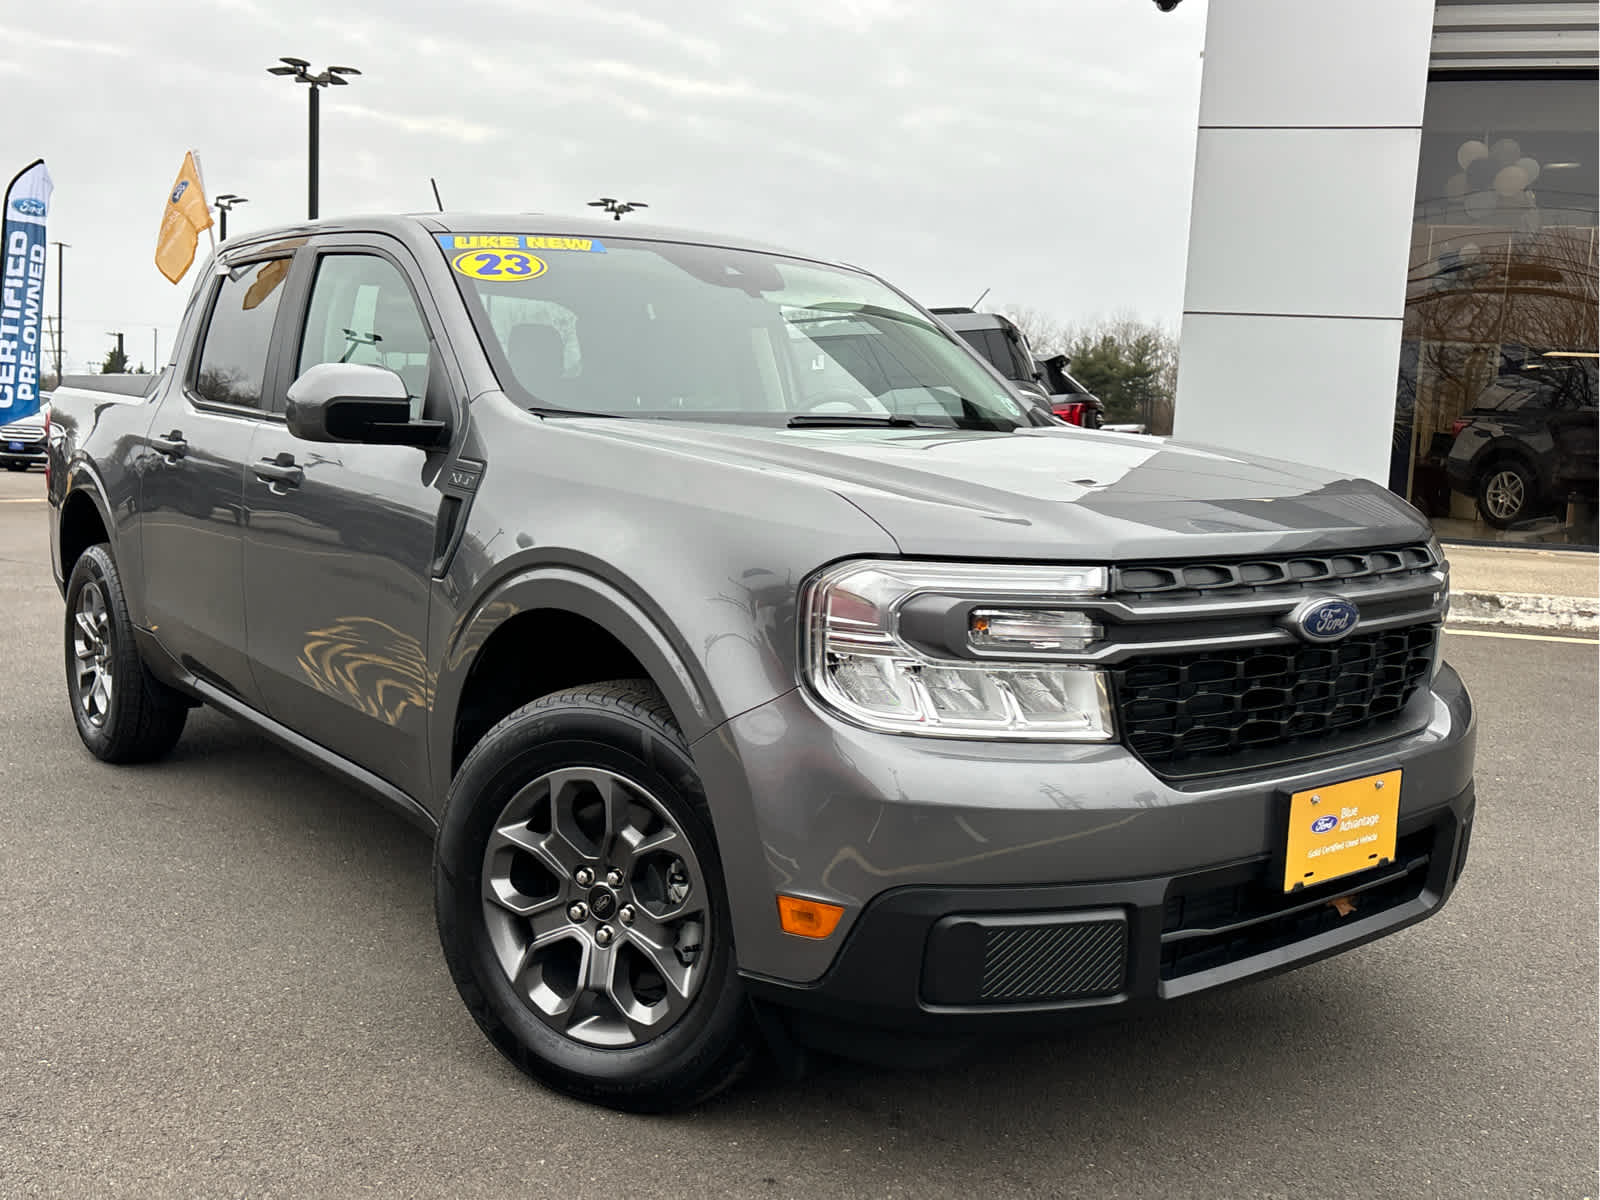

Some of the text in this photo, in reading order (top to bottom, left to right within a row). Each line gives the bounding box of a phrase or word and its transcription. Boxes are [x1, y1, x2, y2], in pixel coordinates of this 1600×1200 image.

[526, 238, 592, 250] NEW
[475, 254, 531, 275] 23
[0, 231, 28, 408] CERTIFIED
[17, 244, 45, 400] PRE-OWNED
[1316, 608, 1349, 632] Ford
[1339, 814, 1380, 832] Advantage
[1340, 807, 1358, 819] Blue
[1315, 817, 1334, 831] Ford
[1307, 833, 1378, 858] Gold Certified Used Vehicle
